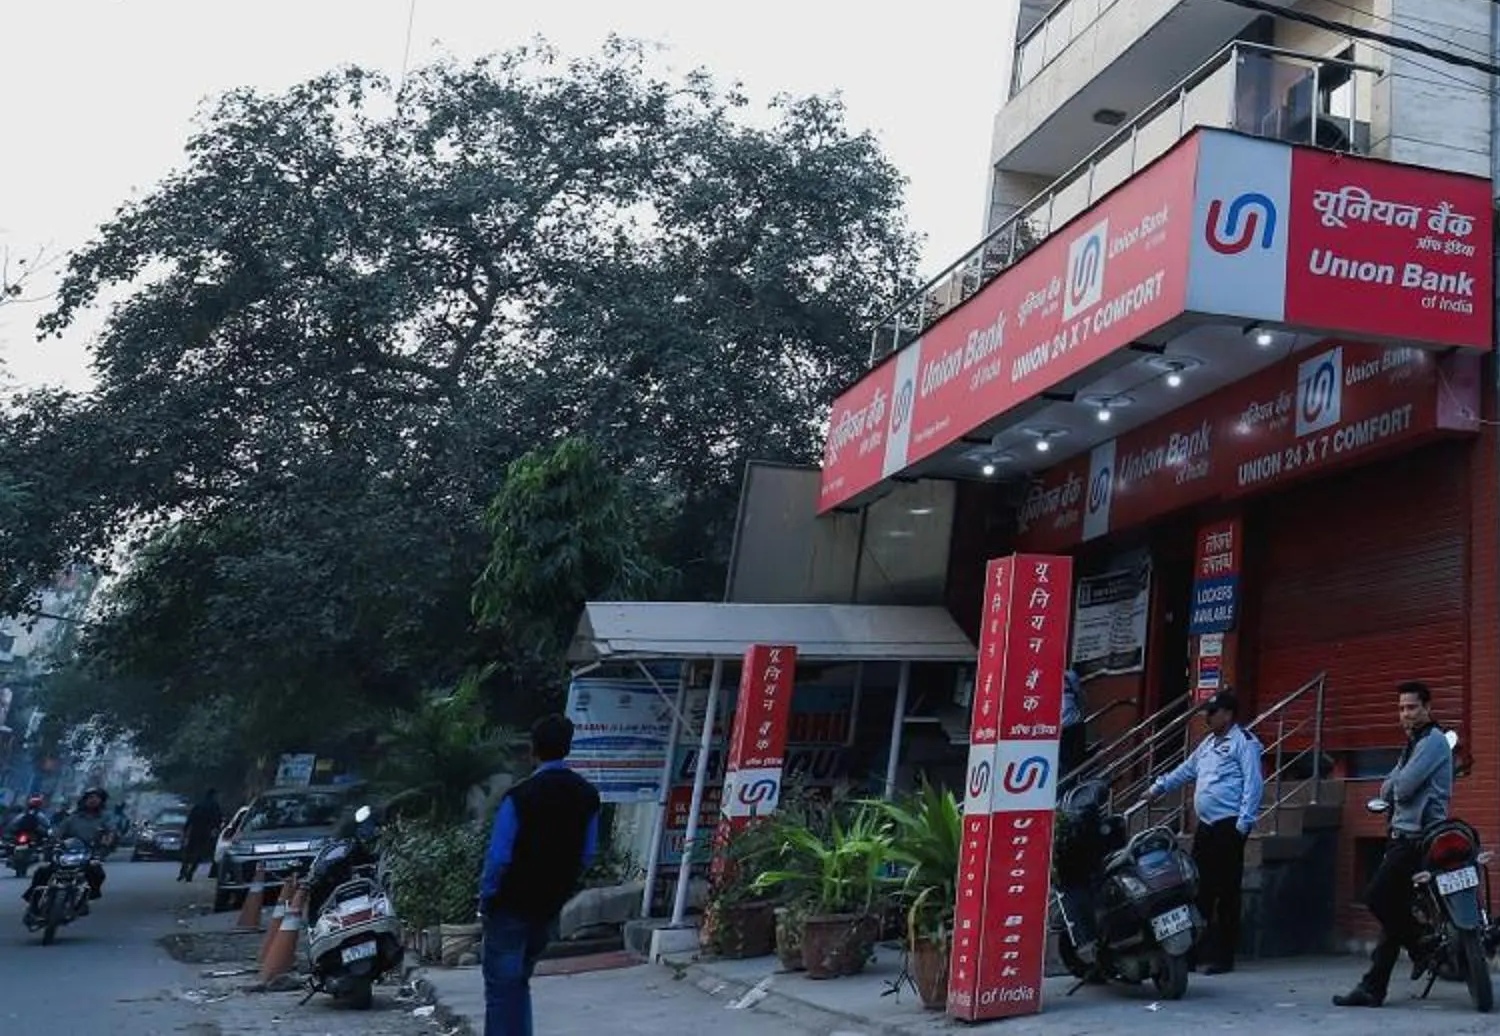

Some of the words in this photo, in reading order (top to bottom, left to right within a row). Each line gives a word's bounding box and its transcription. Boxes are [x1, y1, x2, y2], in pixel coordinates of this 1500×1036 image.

[1312, 186, 1423, 229] यूनियन
[1427, 200, 1476, 237] बैंक
[1309, 248, 1395, 285] Union
[1400, 262, 1476, 296] Bank
[1011, 342, 1050, 383] UNION
[1051, 330, 1068, 359] 24
[1069, 321, 1082, 349] X
[1082, 315, 1092, 341] 7
[1093, 268, 1166, 335] COMFORT
[1421, 295, 1437, 309] of
[1439, 297, 1473, 314] India
[921, 347, 963, 397] Union
[963, 311, 1007, 370] Bank
[1118, 449, 1164, 487] Union
[1238, 451, 1282, 486] UNION
[1283, 446, 1303, 471] 24
[1304, 439, 1316, 461] X
[1319, 435, 1330, 458] 7
[1333, 403, 1413, 453] COMFORT
[1193, 605, 1233, 624] AVAILABLE
[1197, 585, 1233, 605] LOCKERS
[1007, 817, 1034, 895] Union
[1001, 915, 1024, 977] Bank
[981, 989, 997, 1006] of
[999, 985, 1036, 1003] India
